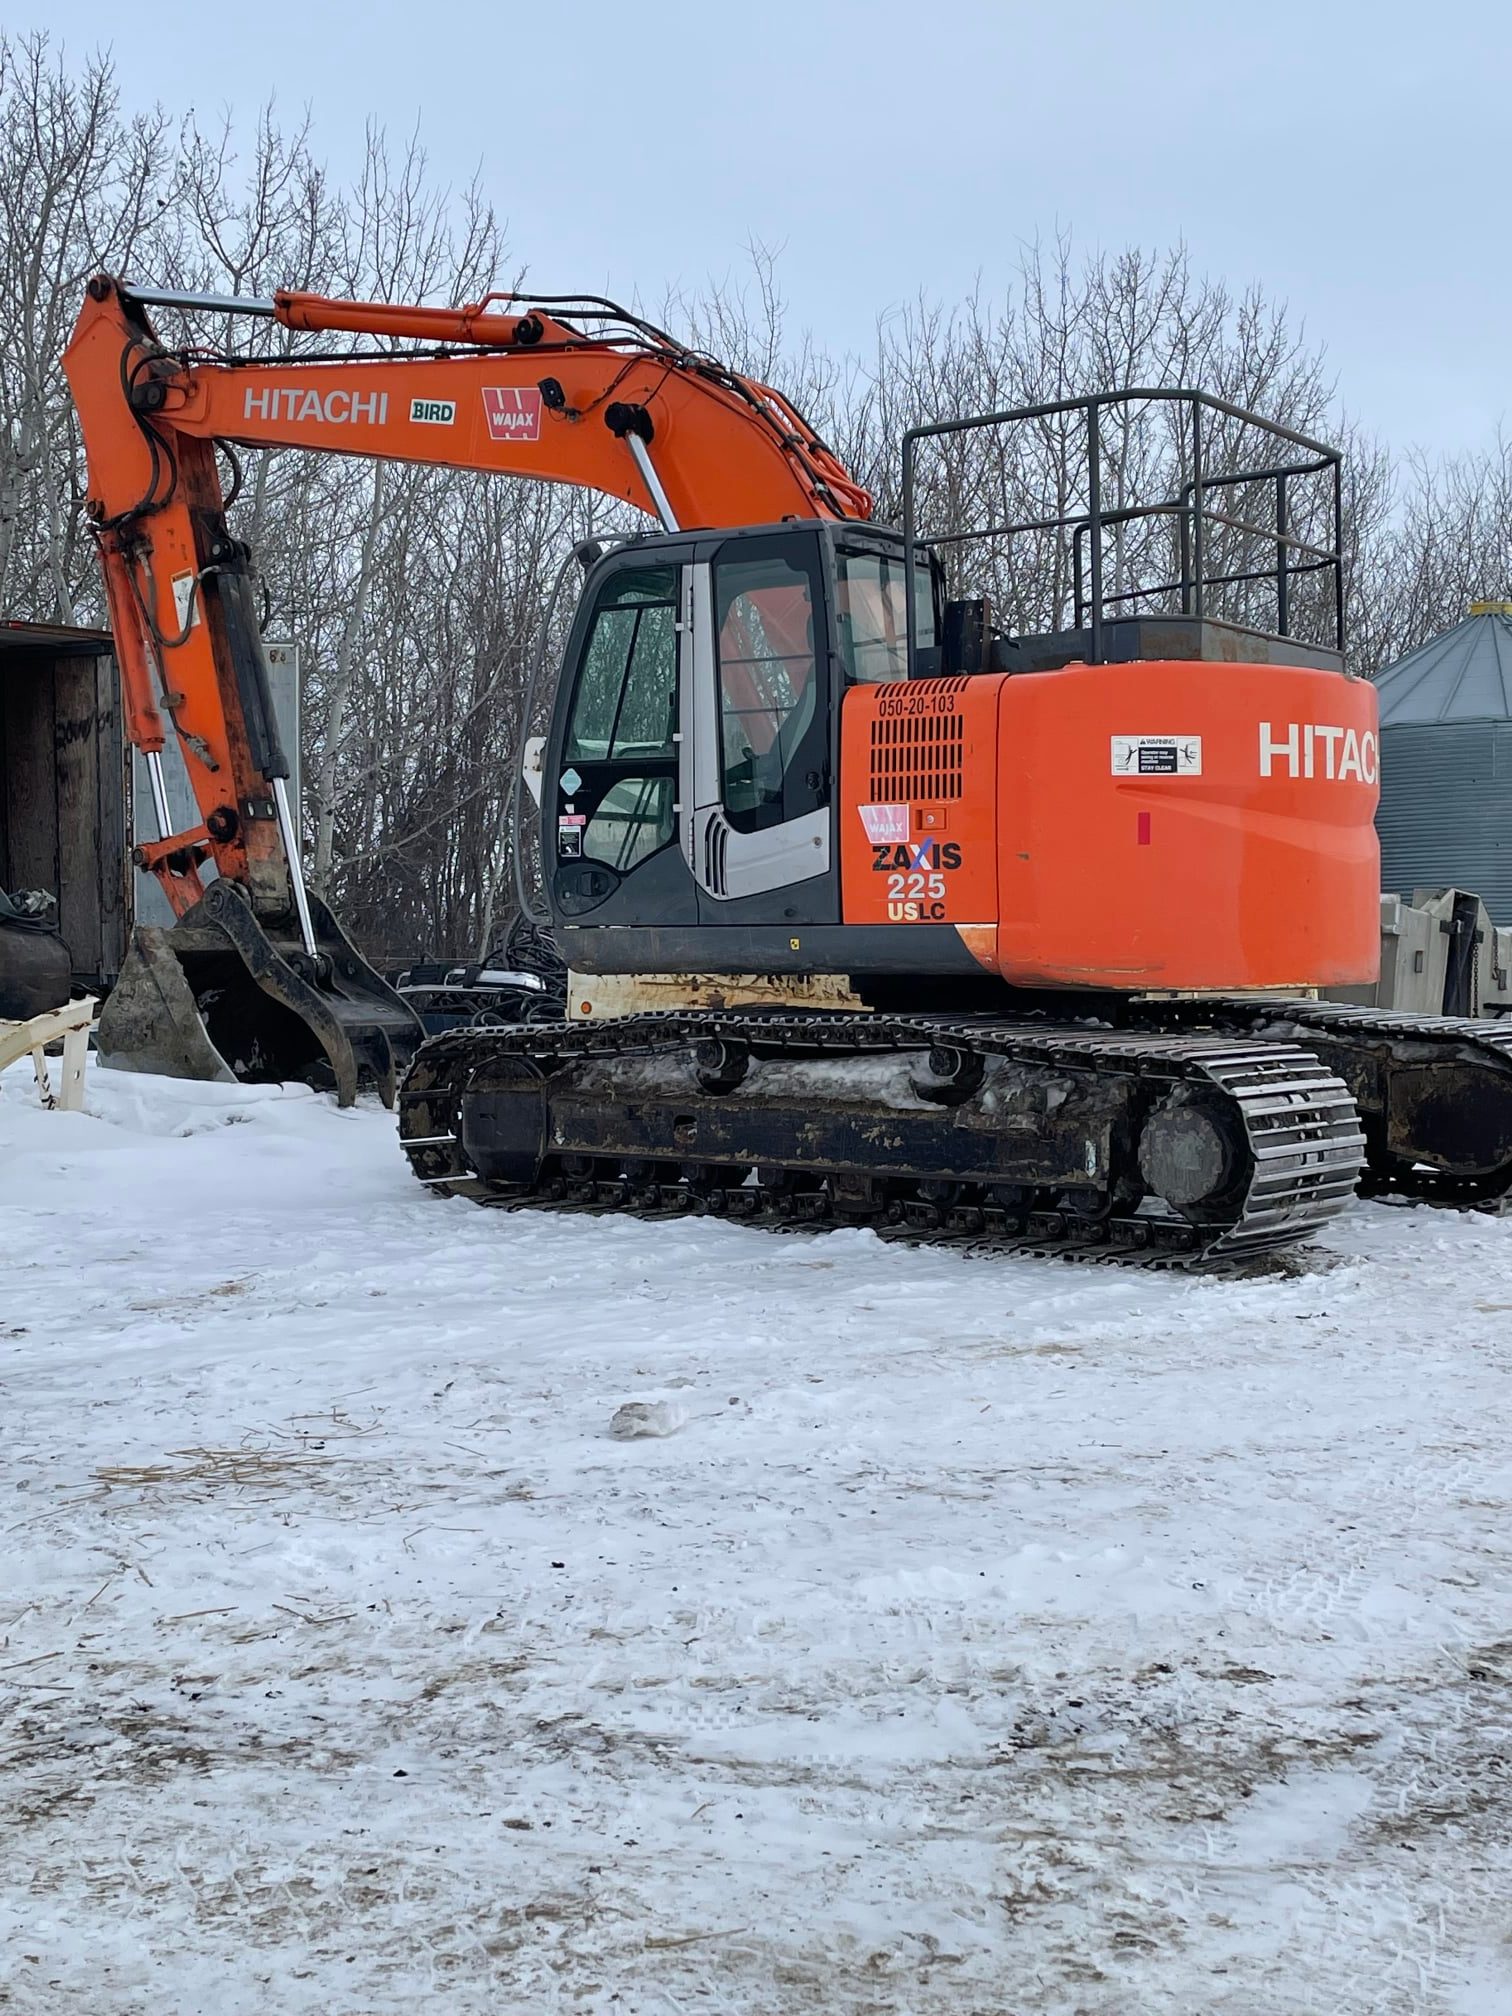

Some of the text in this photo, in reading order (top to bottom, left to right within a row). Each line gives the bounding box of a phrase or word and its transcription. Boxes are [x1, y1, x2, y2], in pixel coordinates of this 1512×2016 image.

[243, 388, 389, 425] HITACHI
[412, 401, 454, 422] BIRD
[492, 412, 534, 430] WAJAX
[879, 694, 955, 717] 050-20-103
[869, 822, 903, 835] WAJAX
[872, 837, 962, 872] ZAXIS
[887, 873, 946, 899] 225
